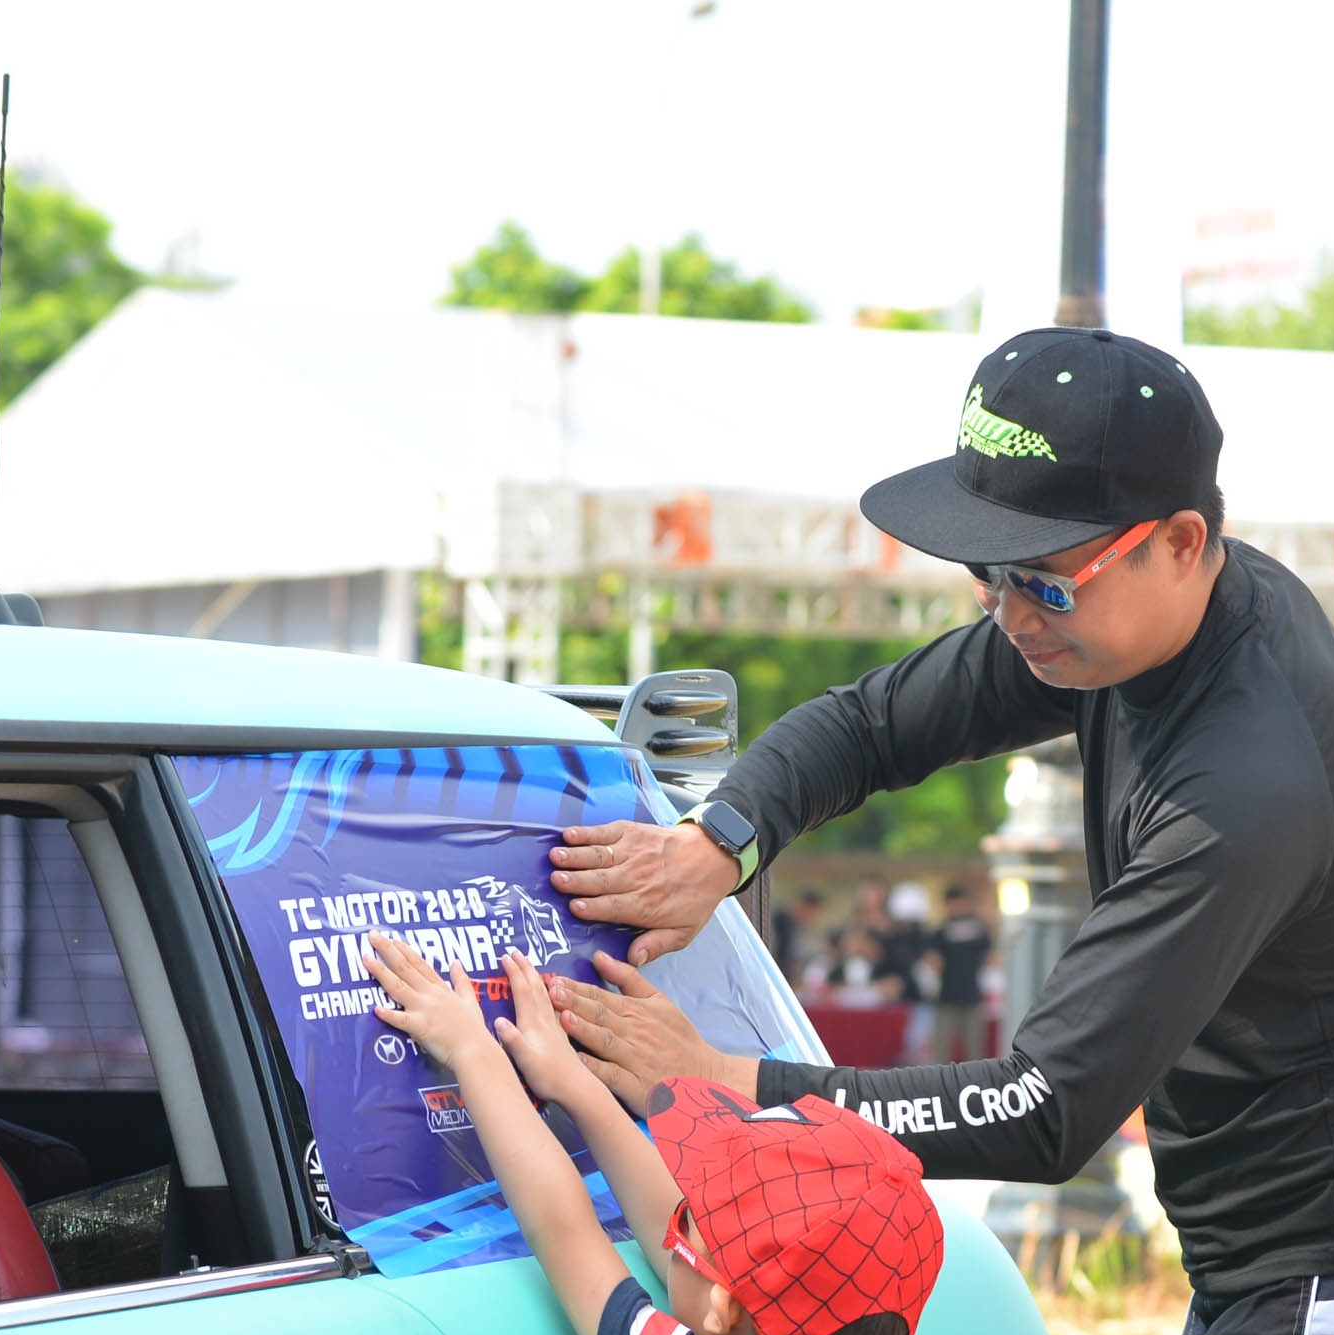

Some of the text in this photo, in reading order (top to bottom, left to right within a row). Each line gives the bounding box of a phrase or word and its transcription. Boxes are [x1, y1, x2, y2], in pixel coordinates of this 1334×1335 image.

[279, 887, 487, 933] TC MOTOR 2020
